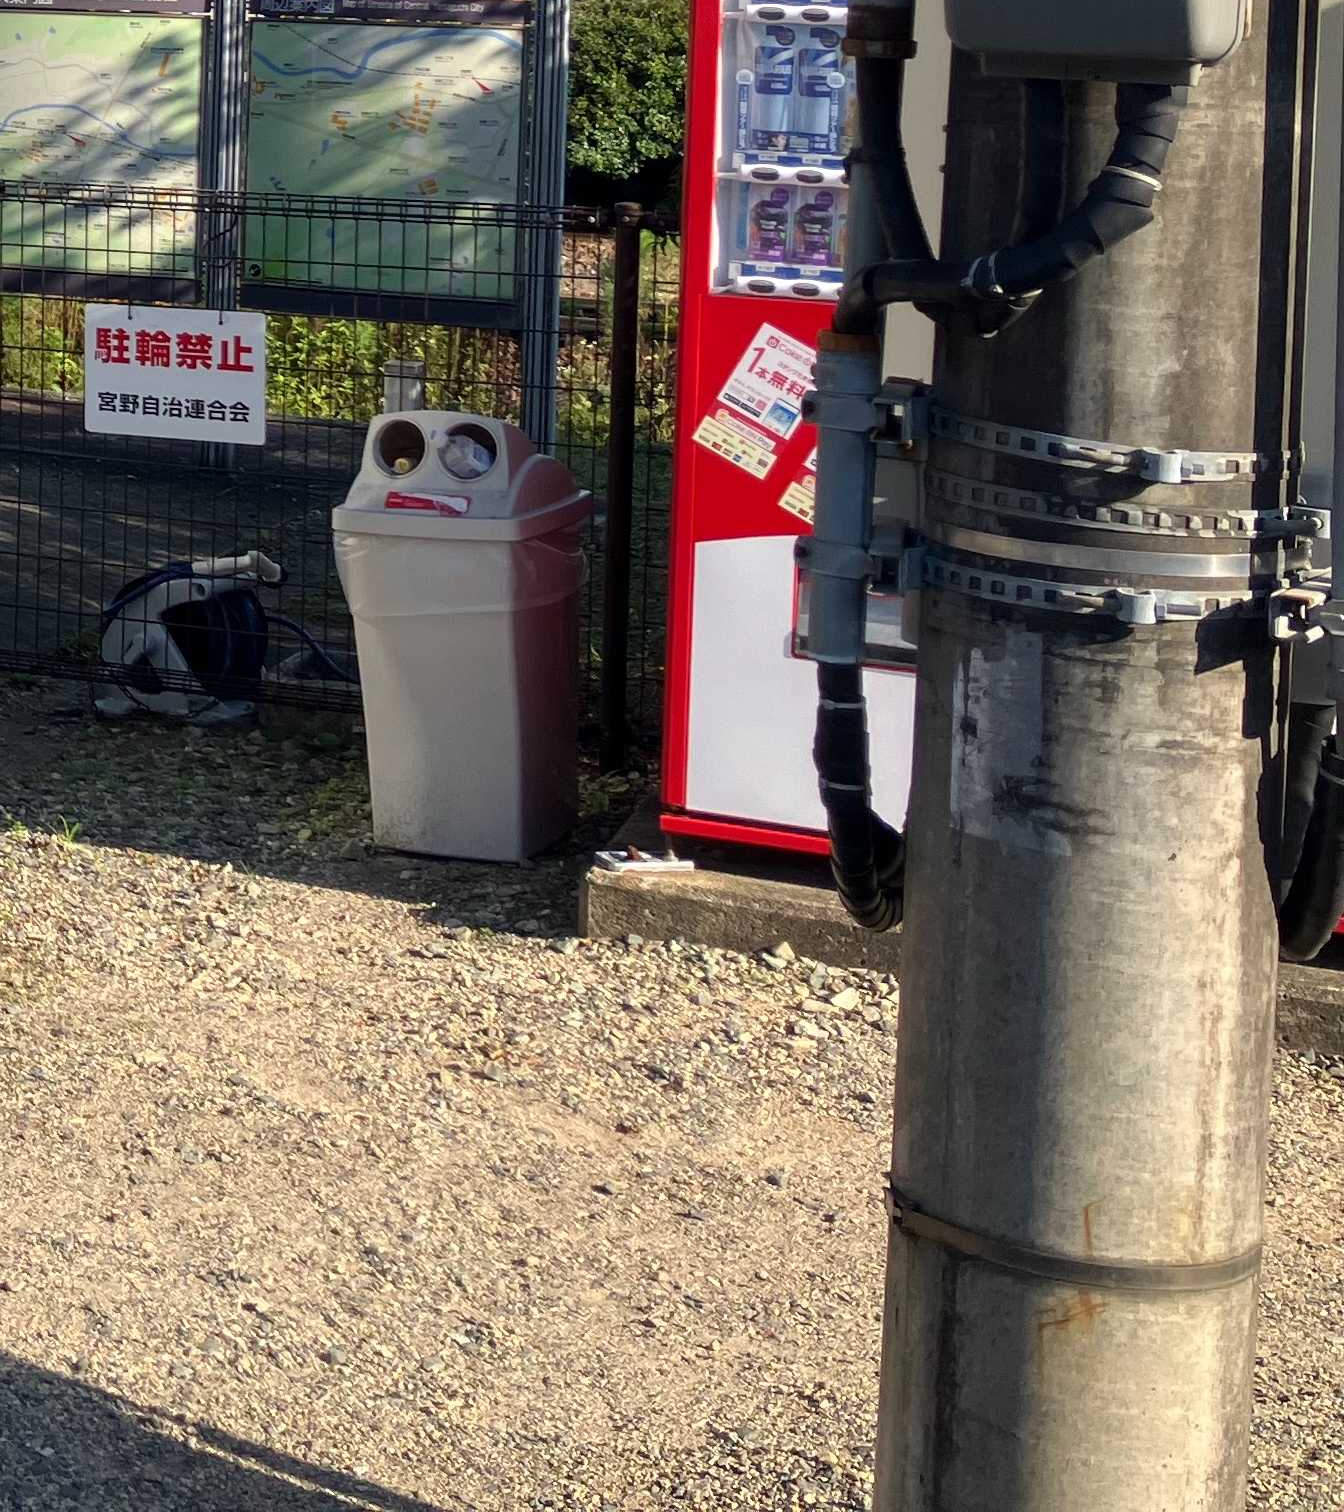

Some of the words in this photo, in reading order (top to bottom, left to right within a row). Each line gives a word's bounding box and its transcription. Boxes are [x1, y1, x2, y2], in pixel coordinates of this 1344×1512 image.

[95, 327, 255, 373] 駐輪禁止
[98, 391, 250, 423] 宮野自治連合会
